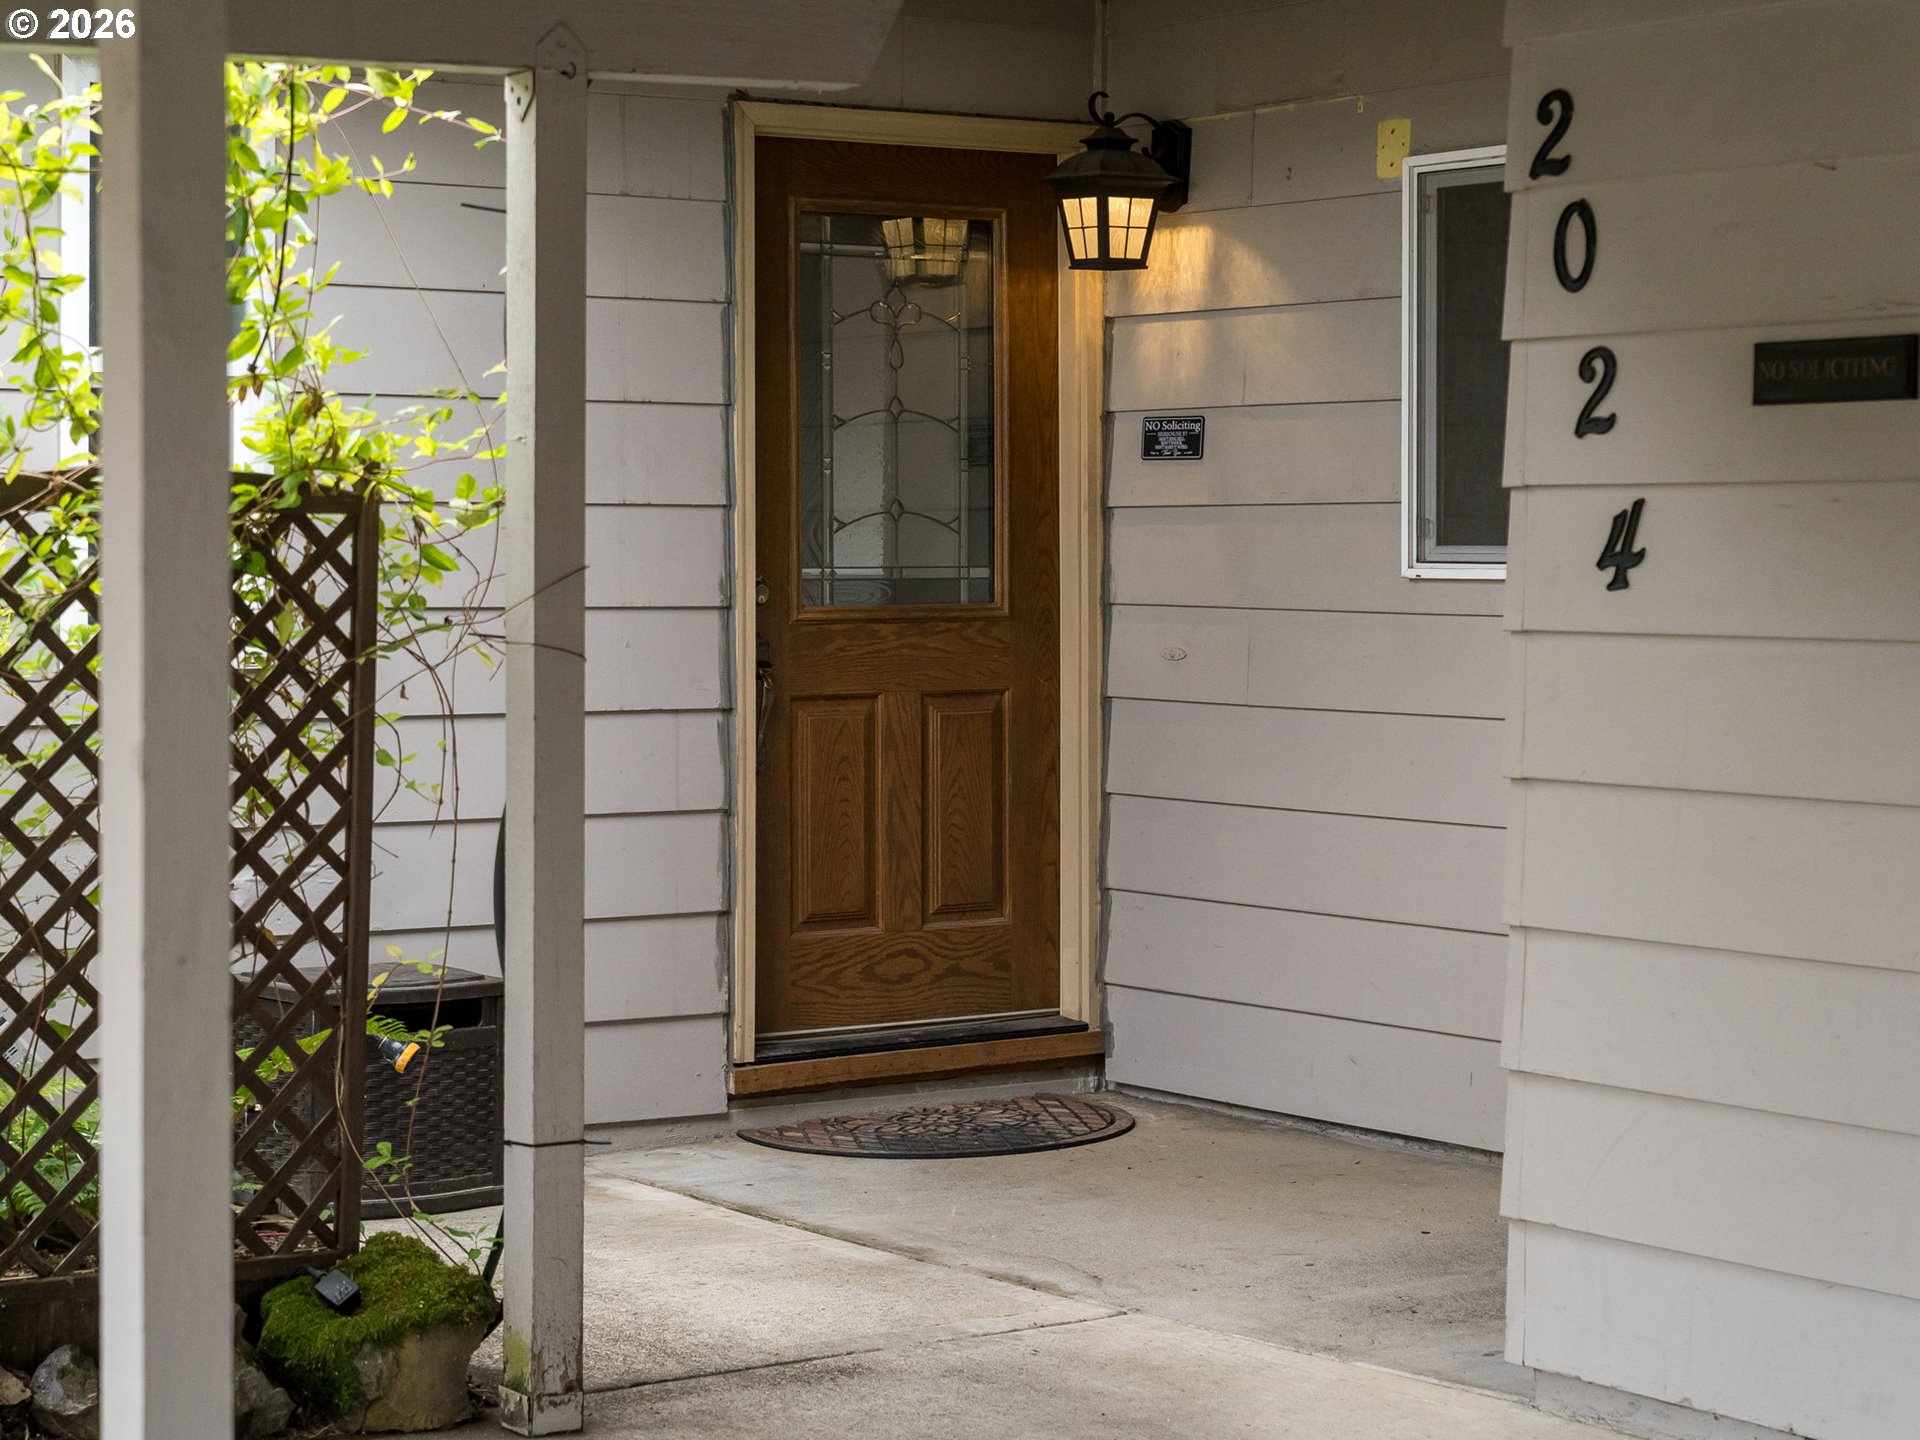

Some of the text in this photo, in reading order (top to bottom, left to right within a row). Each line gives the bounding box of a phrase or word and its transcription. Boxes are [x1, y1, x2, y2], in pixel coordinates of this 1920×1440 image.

[1758, 355, 1897, 382] NO SOLICITING
[1145, 420, 1201, 432] NO Soliciting
